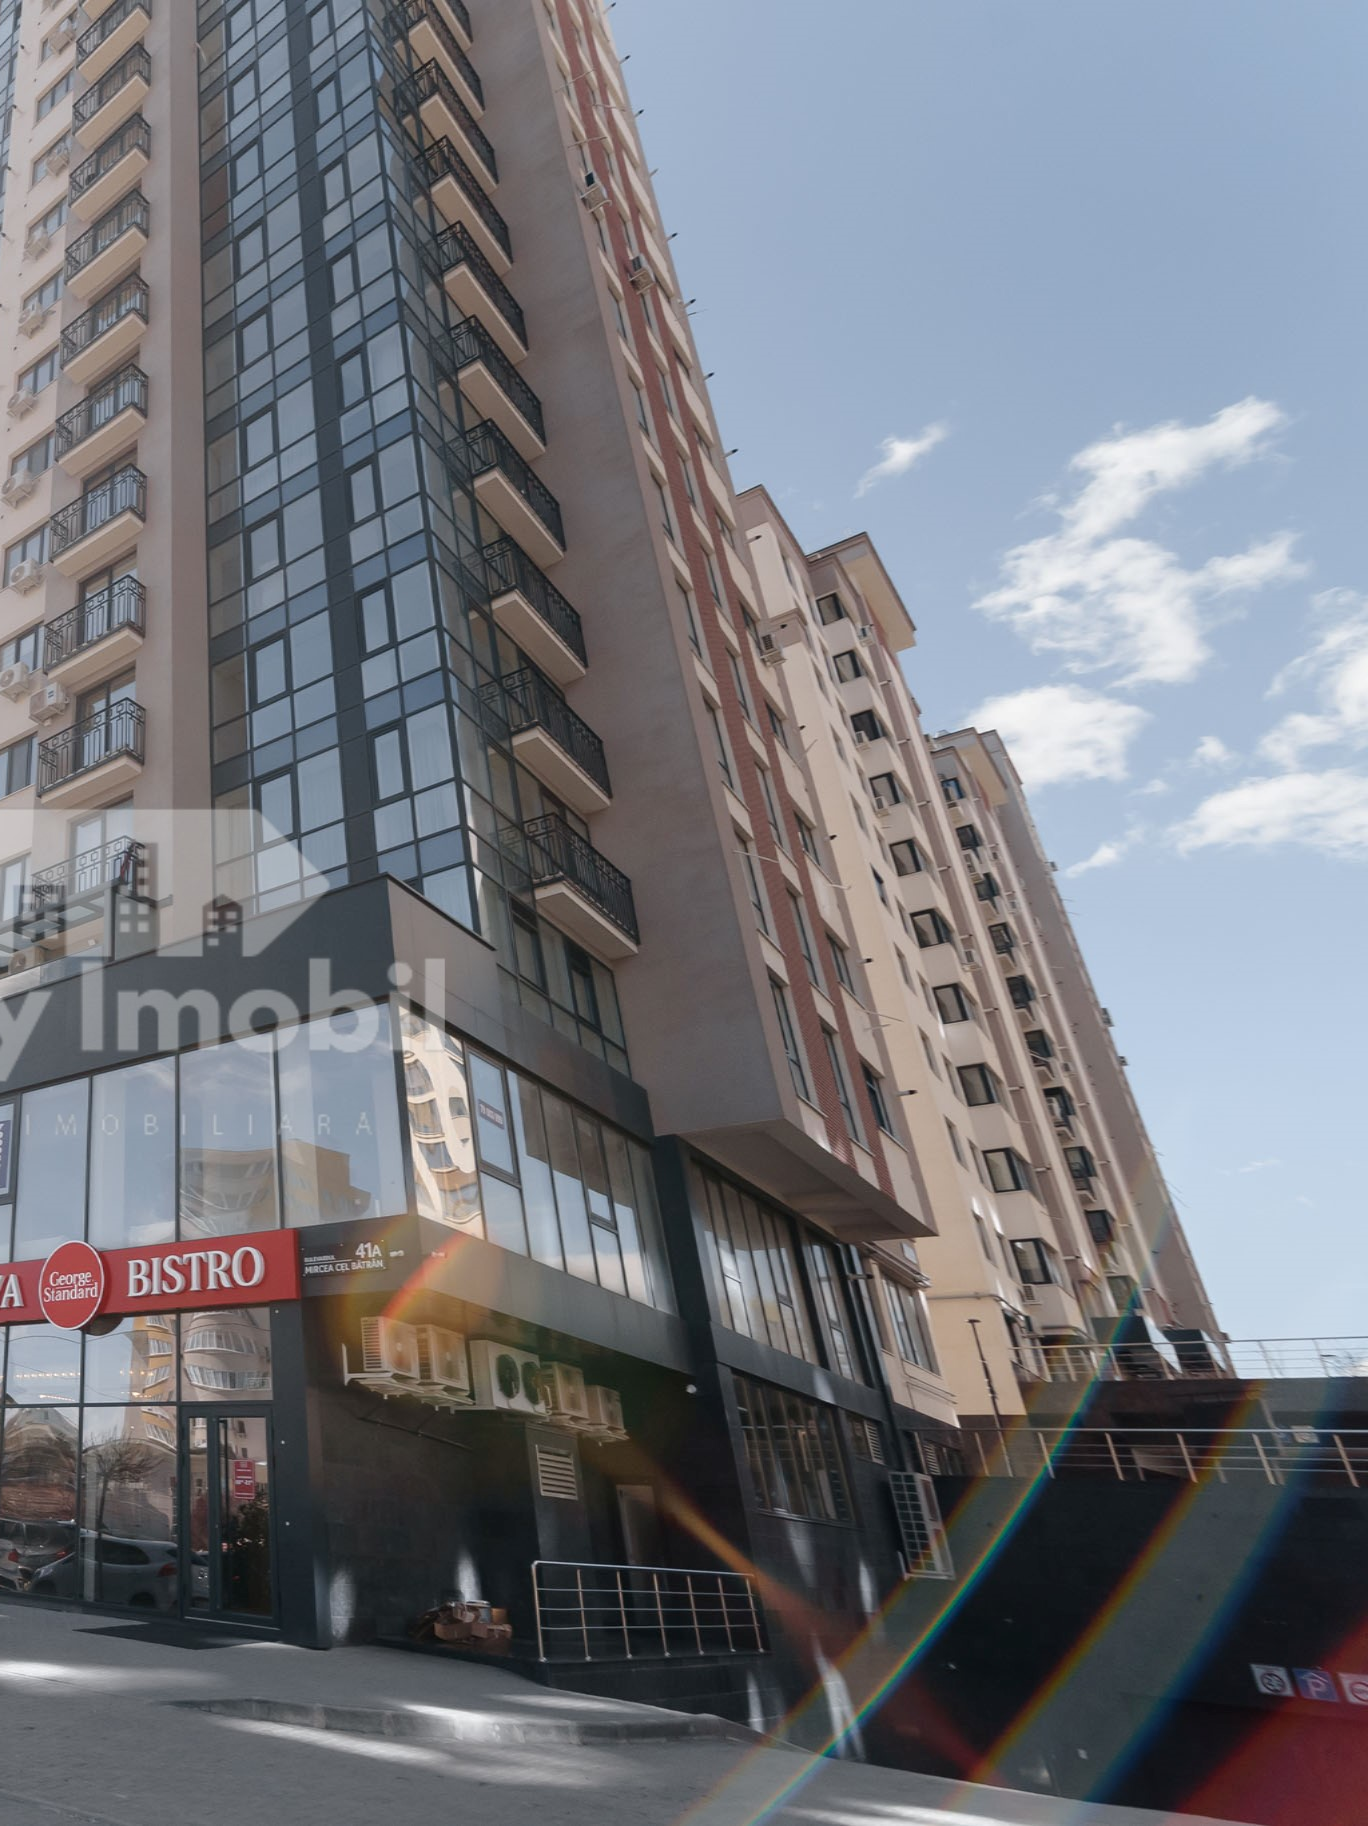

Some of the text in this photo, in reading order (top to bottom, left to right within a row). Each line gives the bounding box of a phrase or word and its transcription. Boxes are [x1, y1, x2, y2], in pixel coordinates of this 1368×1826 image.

[355, 1242, 382, 1258] 41A
[127, 1246, 264, 1297] BISTRO
[304, 1263, 335, 1274] MIRCEA
[49, 1271, 92, 1287] George
[43, 1281, 99, 1302] Standard
